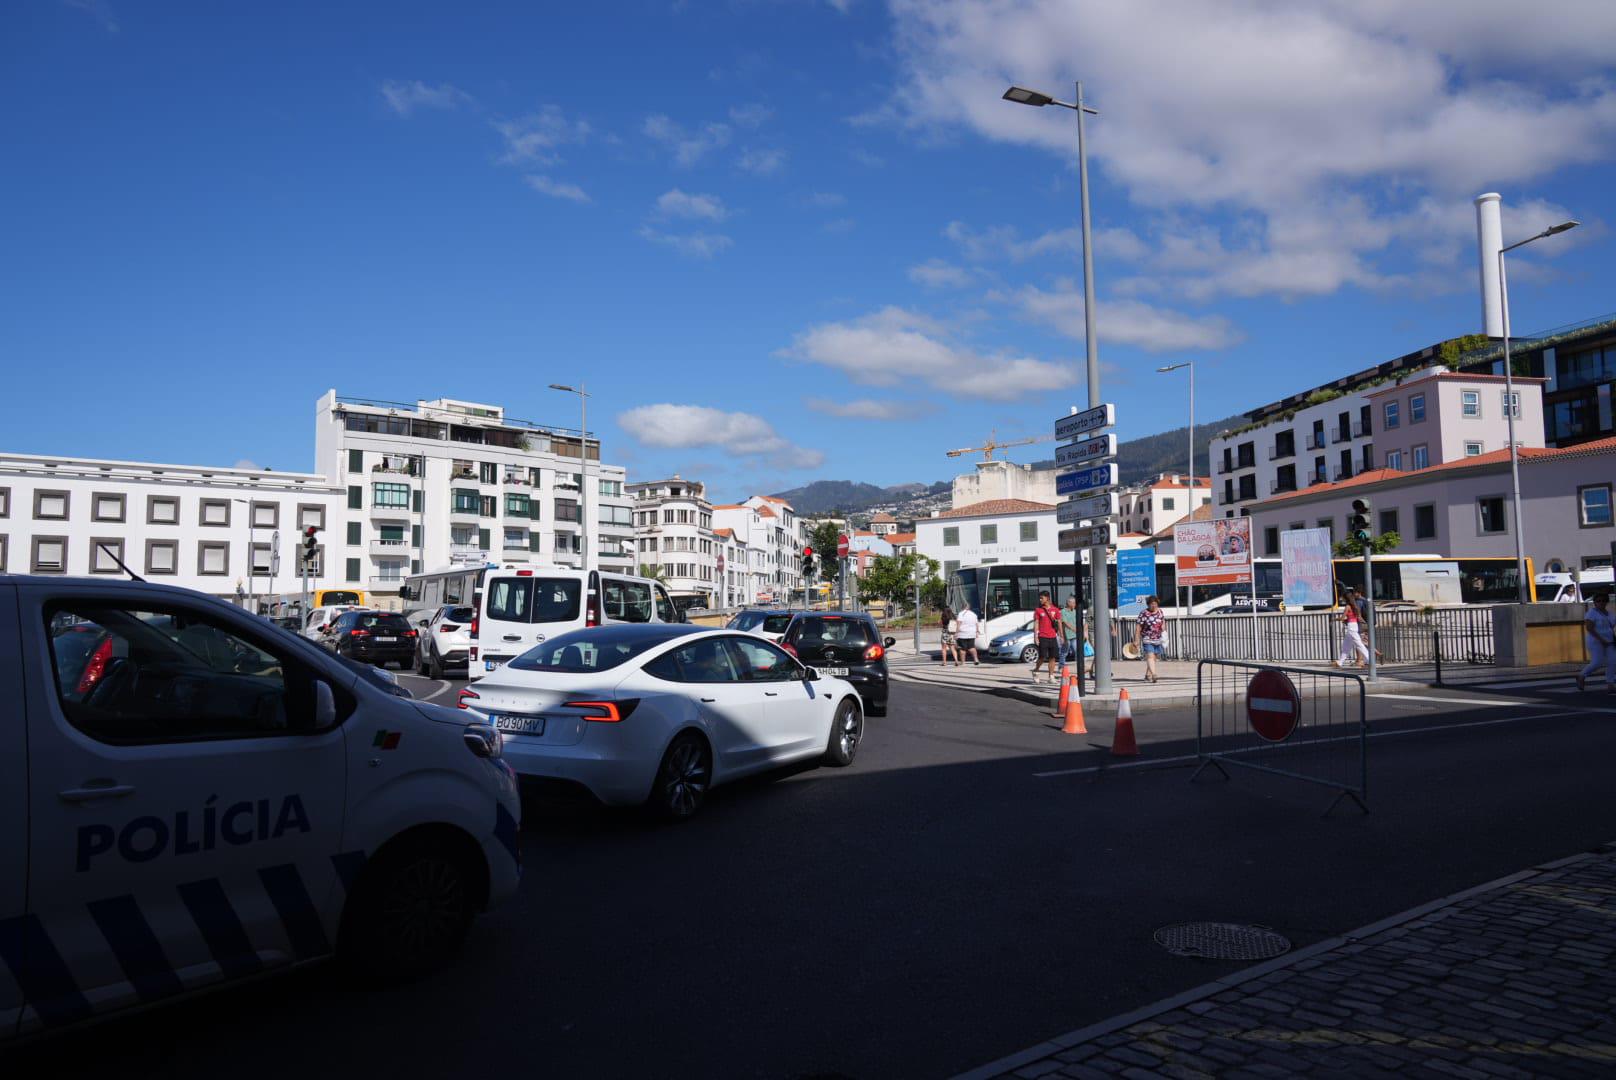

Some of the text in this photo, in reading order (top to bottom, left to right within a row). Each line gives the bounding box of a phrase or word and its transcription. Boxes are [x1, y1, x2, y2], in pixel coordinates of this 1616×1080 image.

[1056, 418, 1088, 436] aeroporto
[1056, 454, 1066, 463] Via
[1177, 528, 1196, 537] CHÃO
[1177, 534, 1211, 543] DA LAGOA
[75, 793, 312, 872] POLÍCIA
